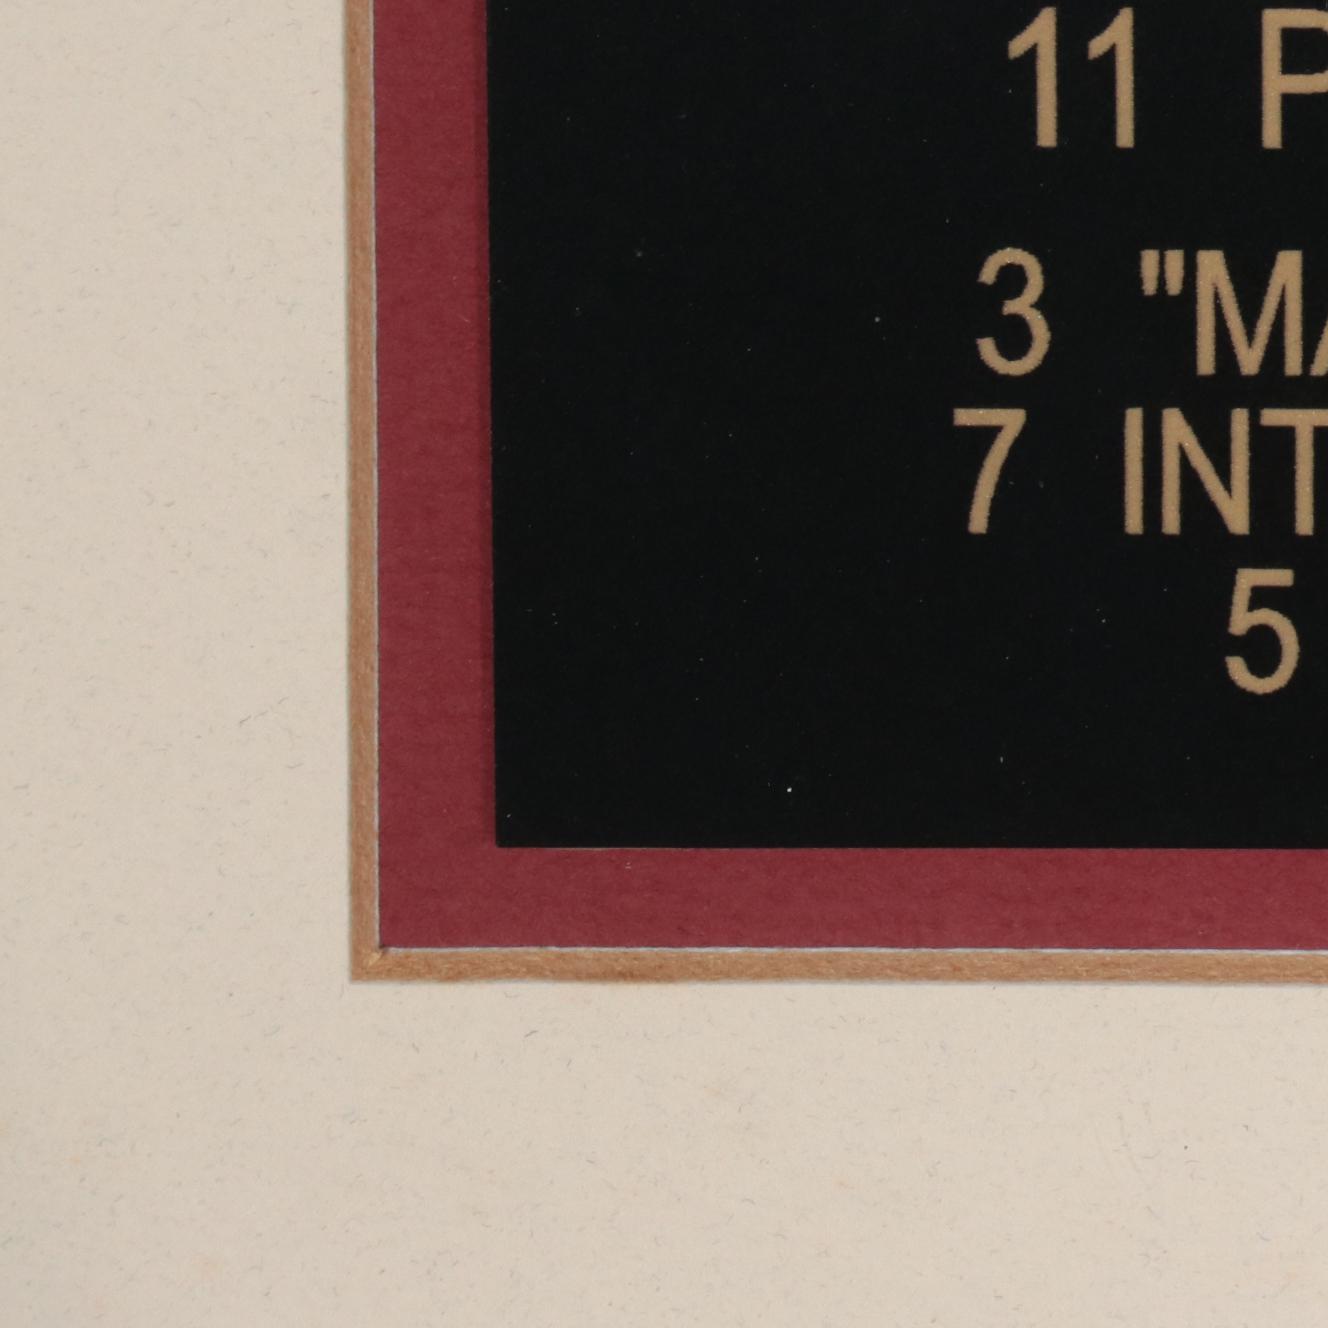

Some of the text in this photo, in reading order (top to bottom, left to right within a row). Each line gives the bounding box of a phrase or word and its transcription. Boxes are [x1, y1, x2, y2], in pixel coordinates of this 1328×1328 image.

[1007, 6, 1136, 149] 11
[976, 246, 1052, 377] 3
[952, 407, 1027, 535] 7
[1224, 567, 1301, 696] 5
